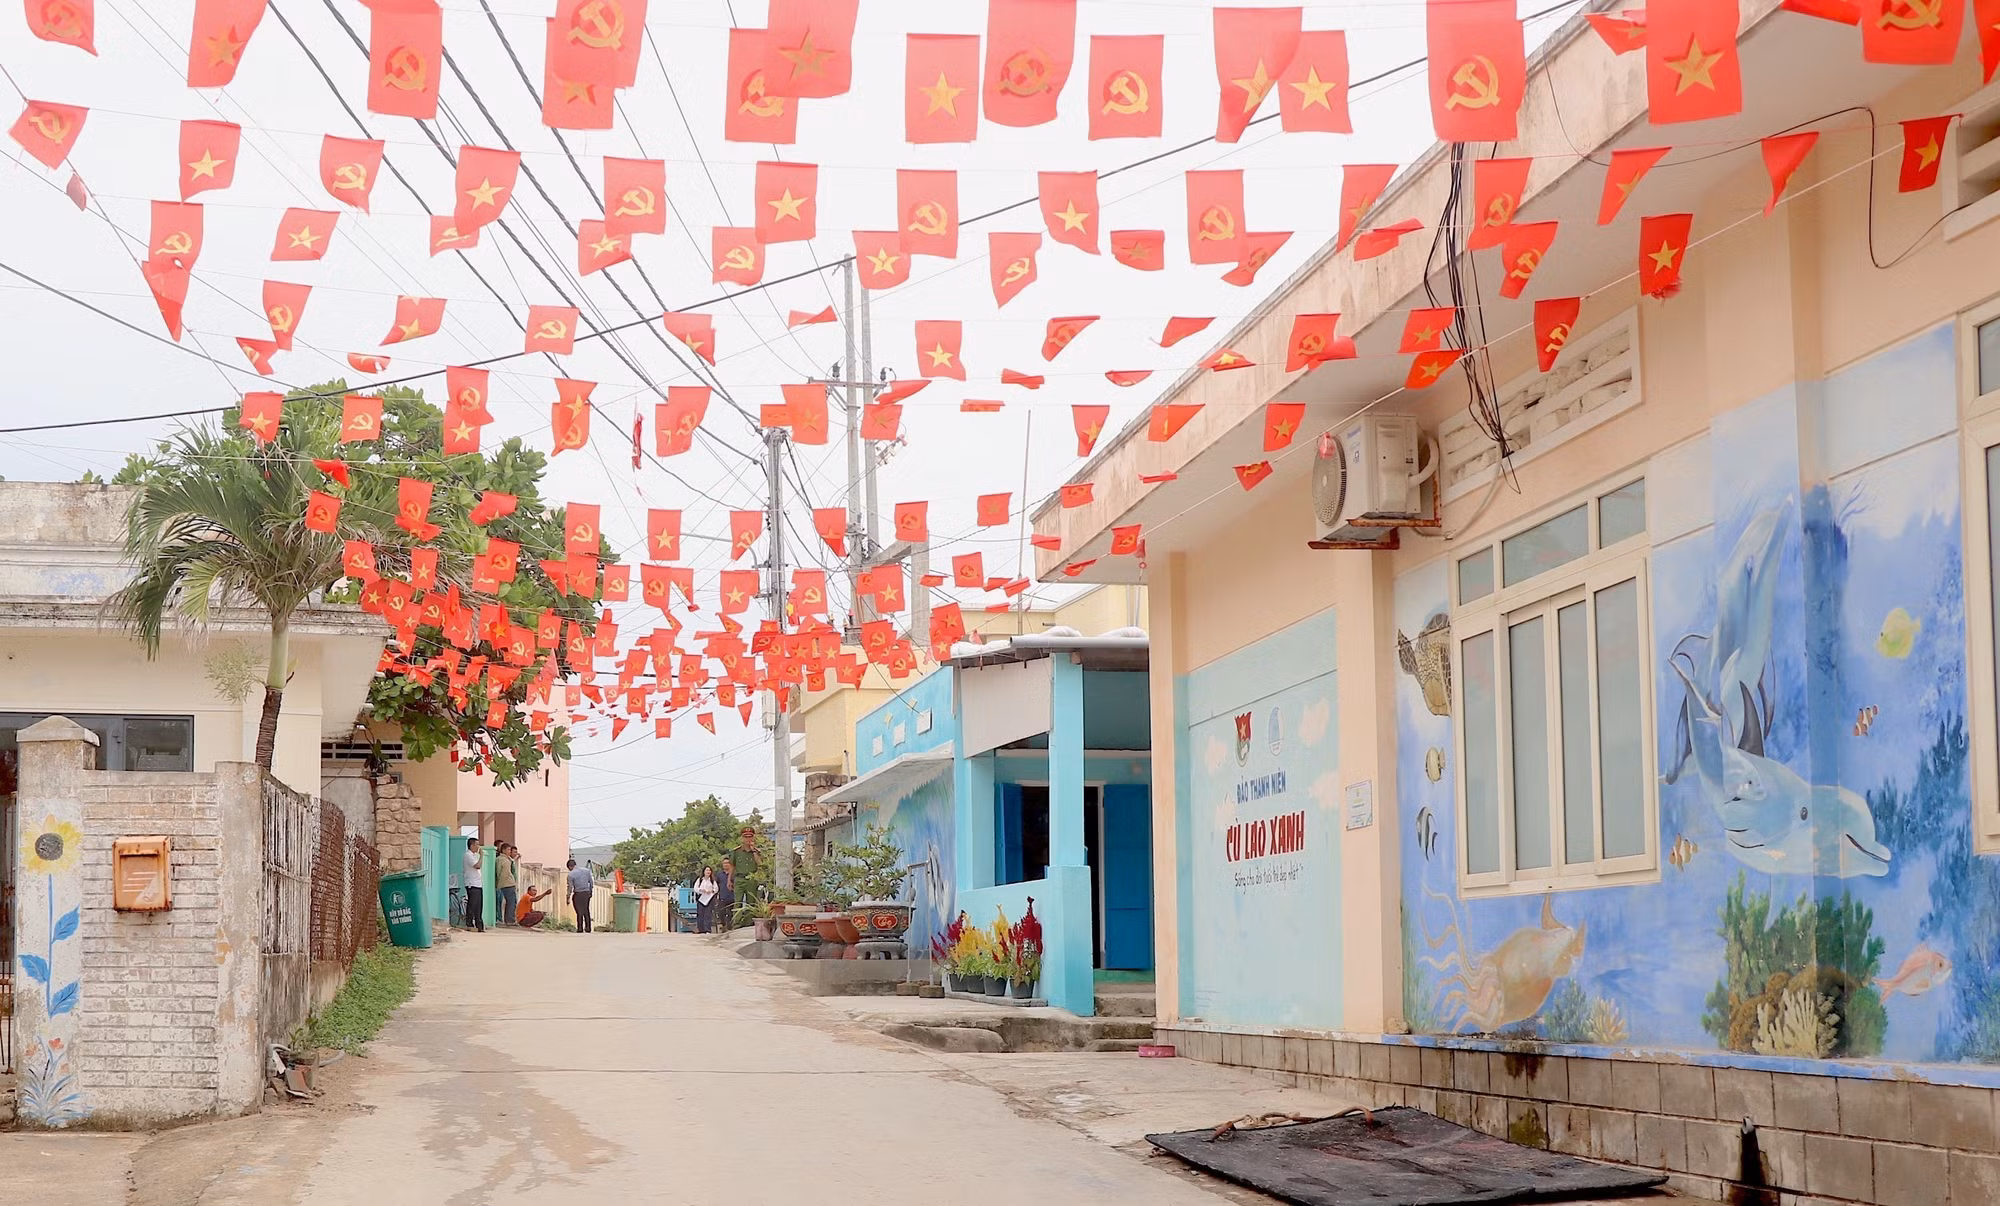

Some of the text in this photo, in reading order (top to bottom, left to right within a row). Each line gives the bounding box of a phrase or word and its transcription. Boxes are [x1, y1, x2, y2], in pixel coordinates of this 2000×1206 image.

[1250, 775, 1270, 800] THANH
[1271, 767, 1286, 796] NIÊN
[1226, 810, 1304, 863] CÙ LAO XANH
